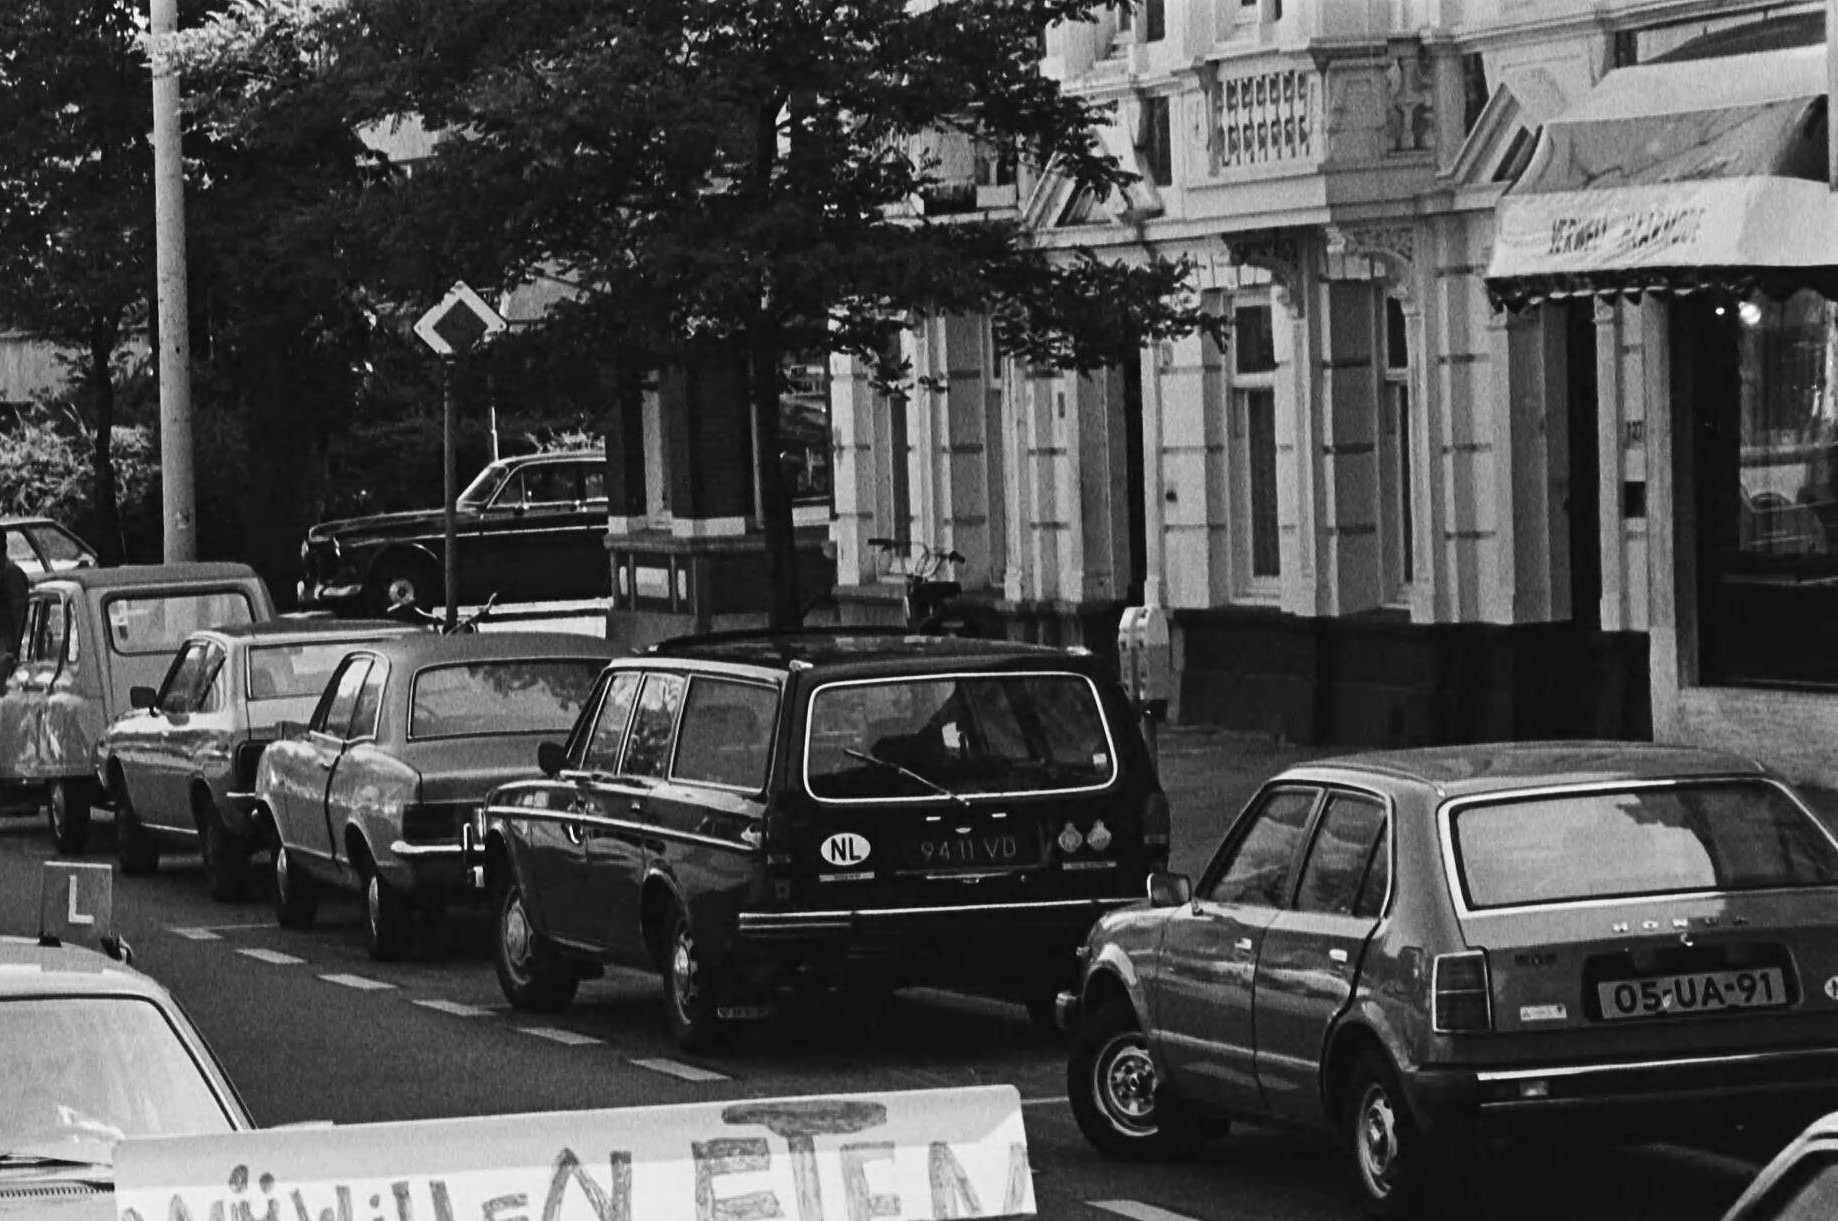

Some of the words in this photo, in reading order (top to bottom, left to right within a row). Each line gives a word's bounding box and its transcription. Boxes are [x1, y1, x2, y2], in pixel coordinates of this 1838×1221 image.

[831, 836, 862, 862] NL
[68, 874, 95, 924] L
[1614, 972, 1775, 1014] 05-UA-91
